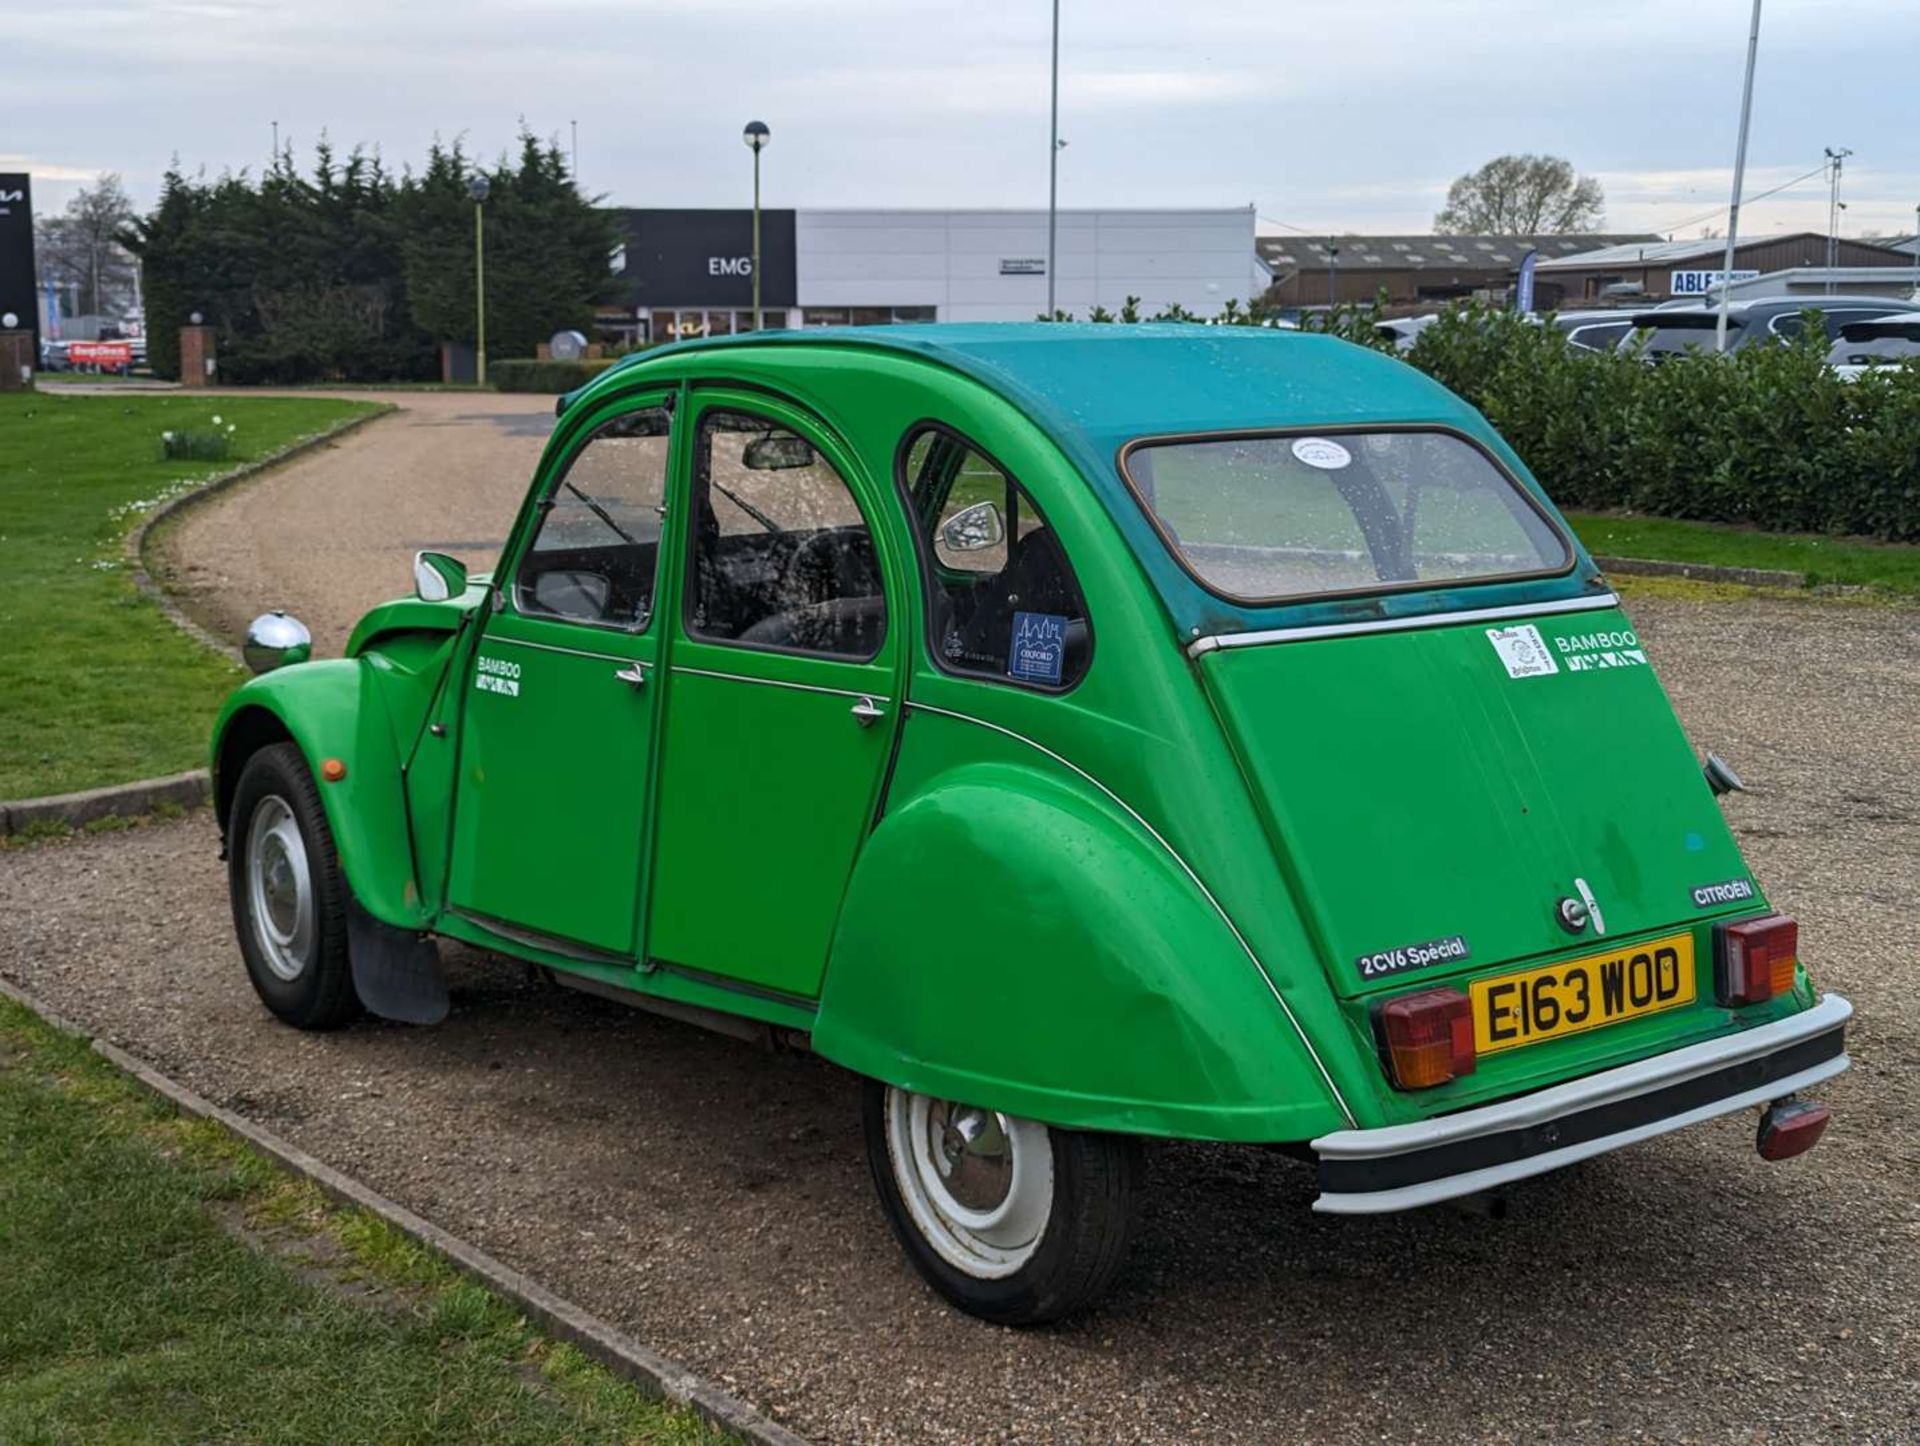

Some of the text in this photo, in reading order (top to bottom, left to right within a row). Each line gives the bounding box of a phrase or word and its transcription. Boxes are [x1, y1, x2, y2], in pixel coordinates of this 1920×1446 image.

[709, 257, 752, 275] EMG
[1555, 632, 1637, 653] BAMBOO
[1020, 649, 1054, 661] OXFORD
[478, 656, 521, 679] BAMBOO
[1694, 880, 1752, 904] CITROËN
[1361, 938, 1467, 975] 2CV6 Spécial
[1488, 947, 1680, 1042] E163 WOD
